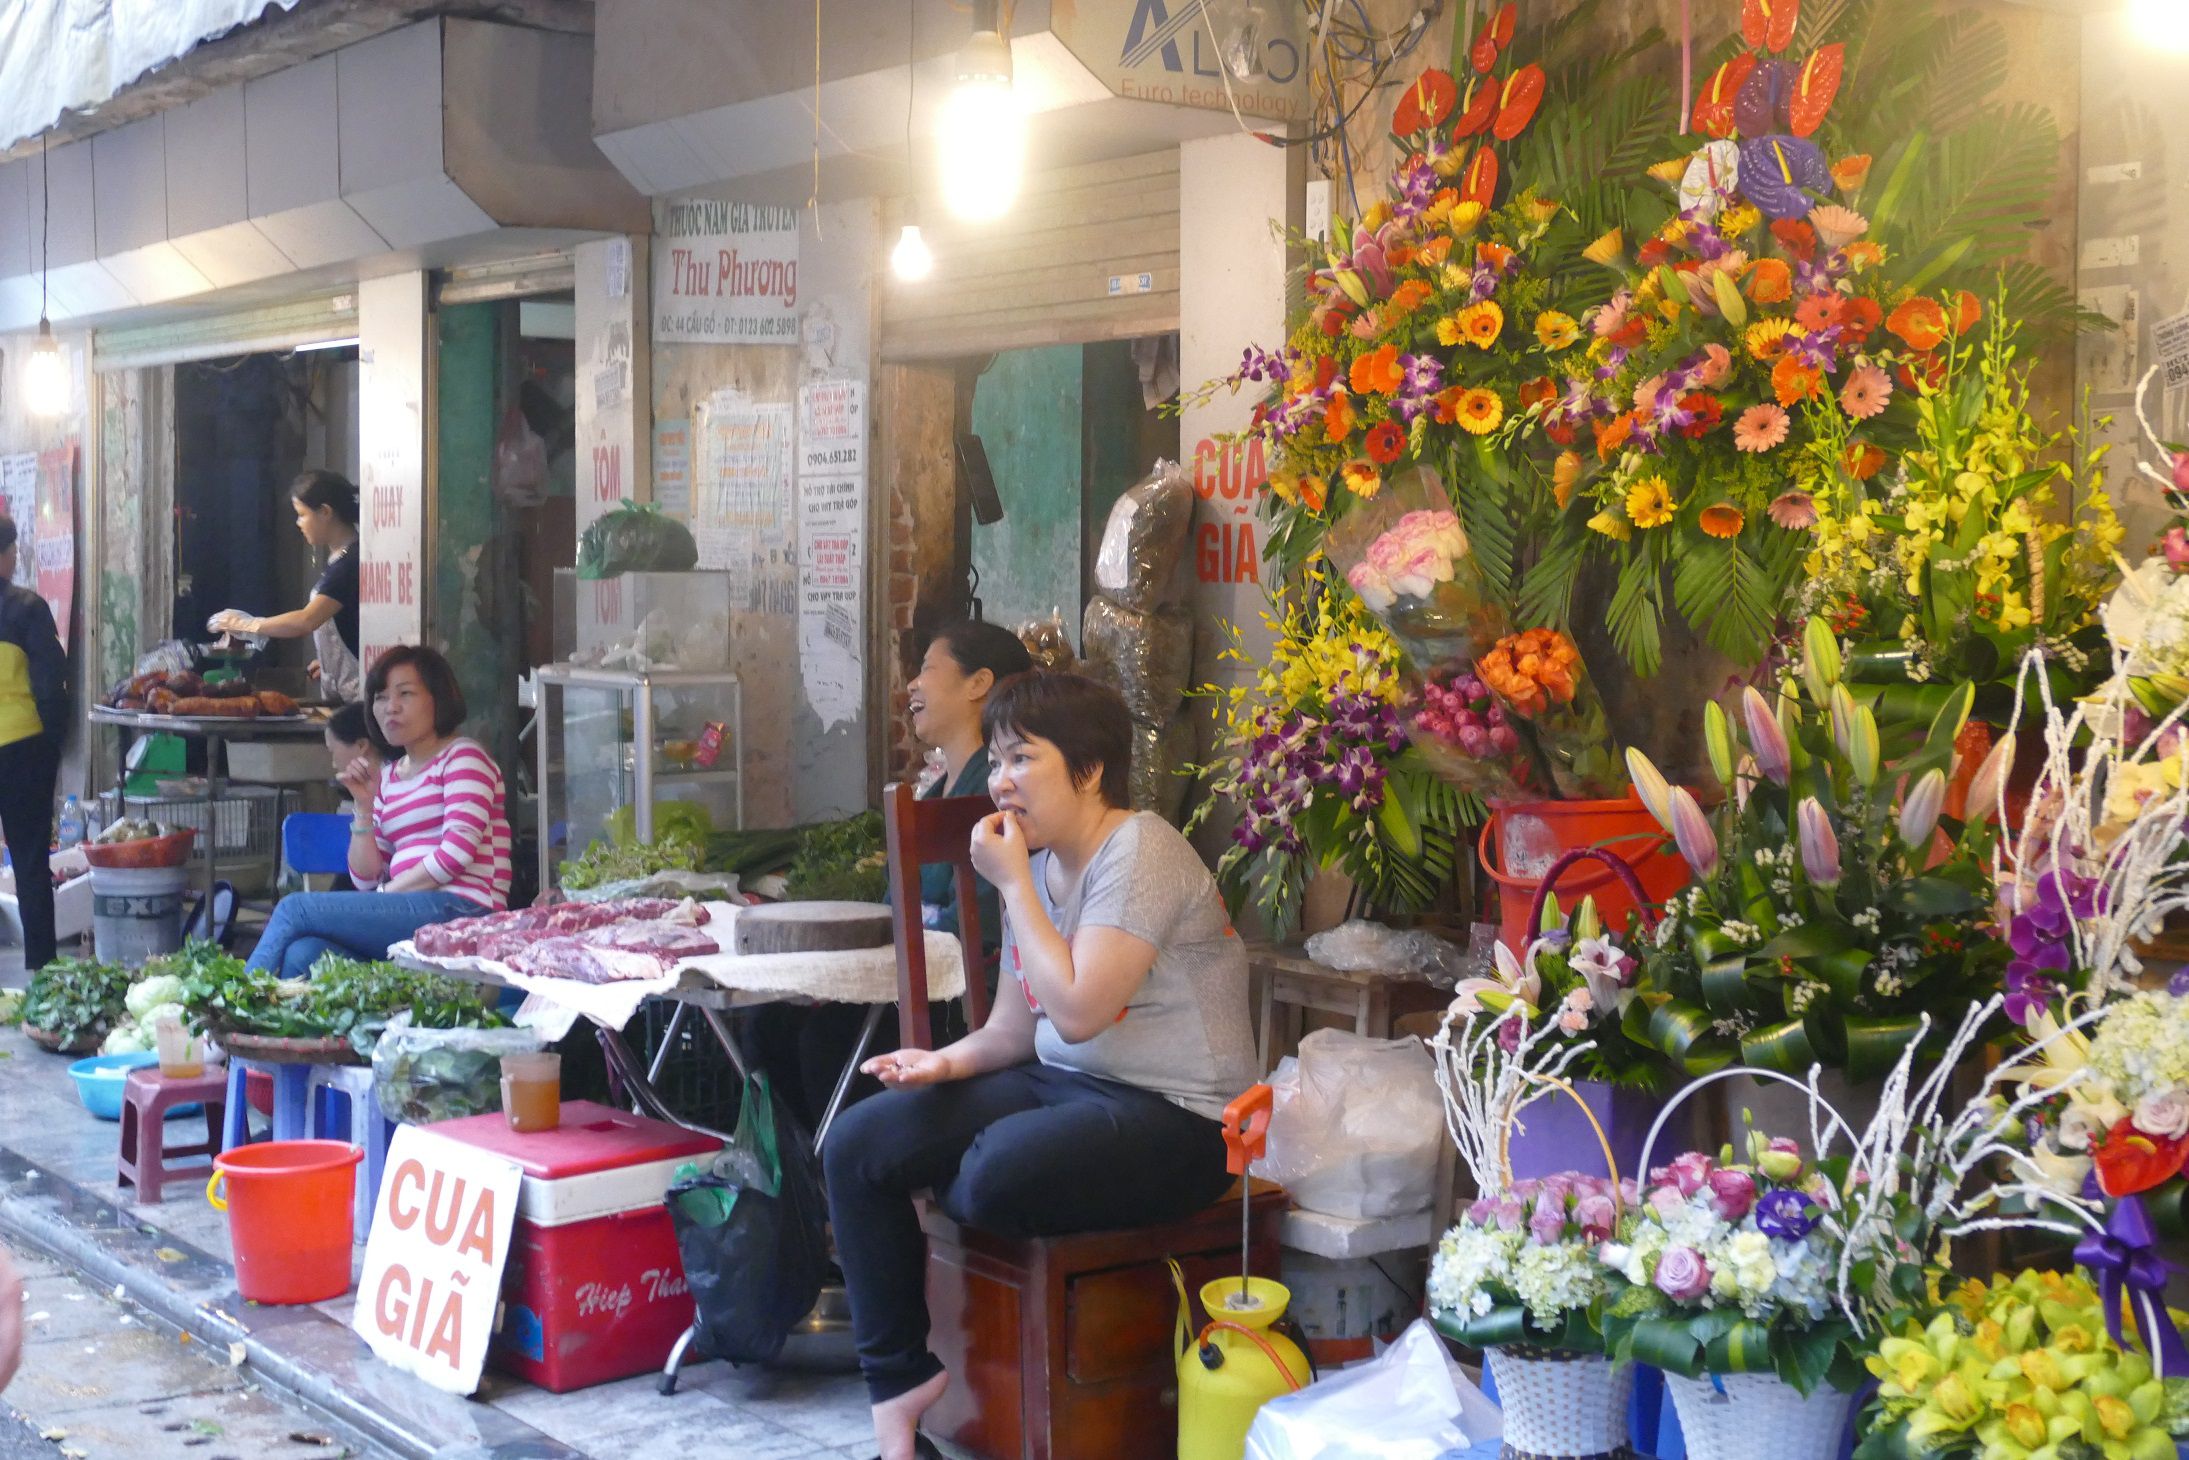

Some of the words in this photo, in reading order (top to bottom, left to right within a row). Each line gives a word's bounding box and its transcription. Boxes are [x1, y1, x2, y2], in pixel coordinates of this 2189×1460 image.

[1121, 79, 1173, 102] Euro
[1182, 85, 1299, 117] technology
[704, 200, 727, 236] NAM
[731, 201, 749, 234] GIA
[672, 249, 710, 296] Thu
[716, 248, 797, 308] Phương
[676, 315, 685, 331] 44
[739, 316, 758, 335] 0123
[760, 317, 774, 335] 602
[1196, 504, 1259, 583] GIÃ
[387, 1157, 495, 1267] CUA
[374, 1262, 472, 1371] GIÃ
